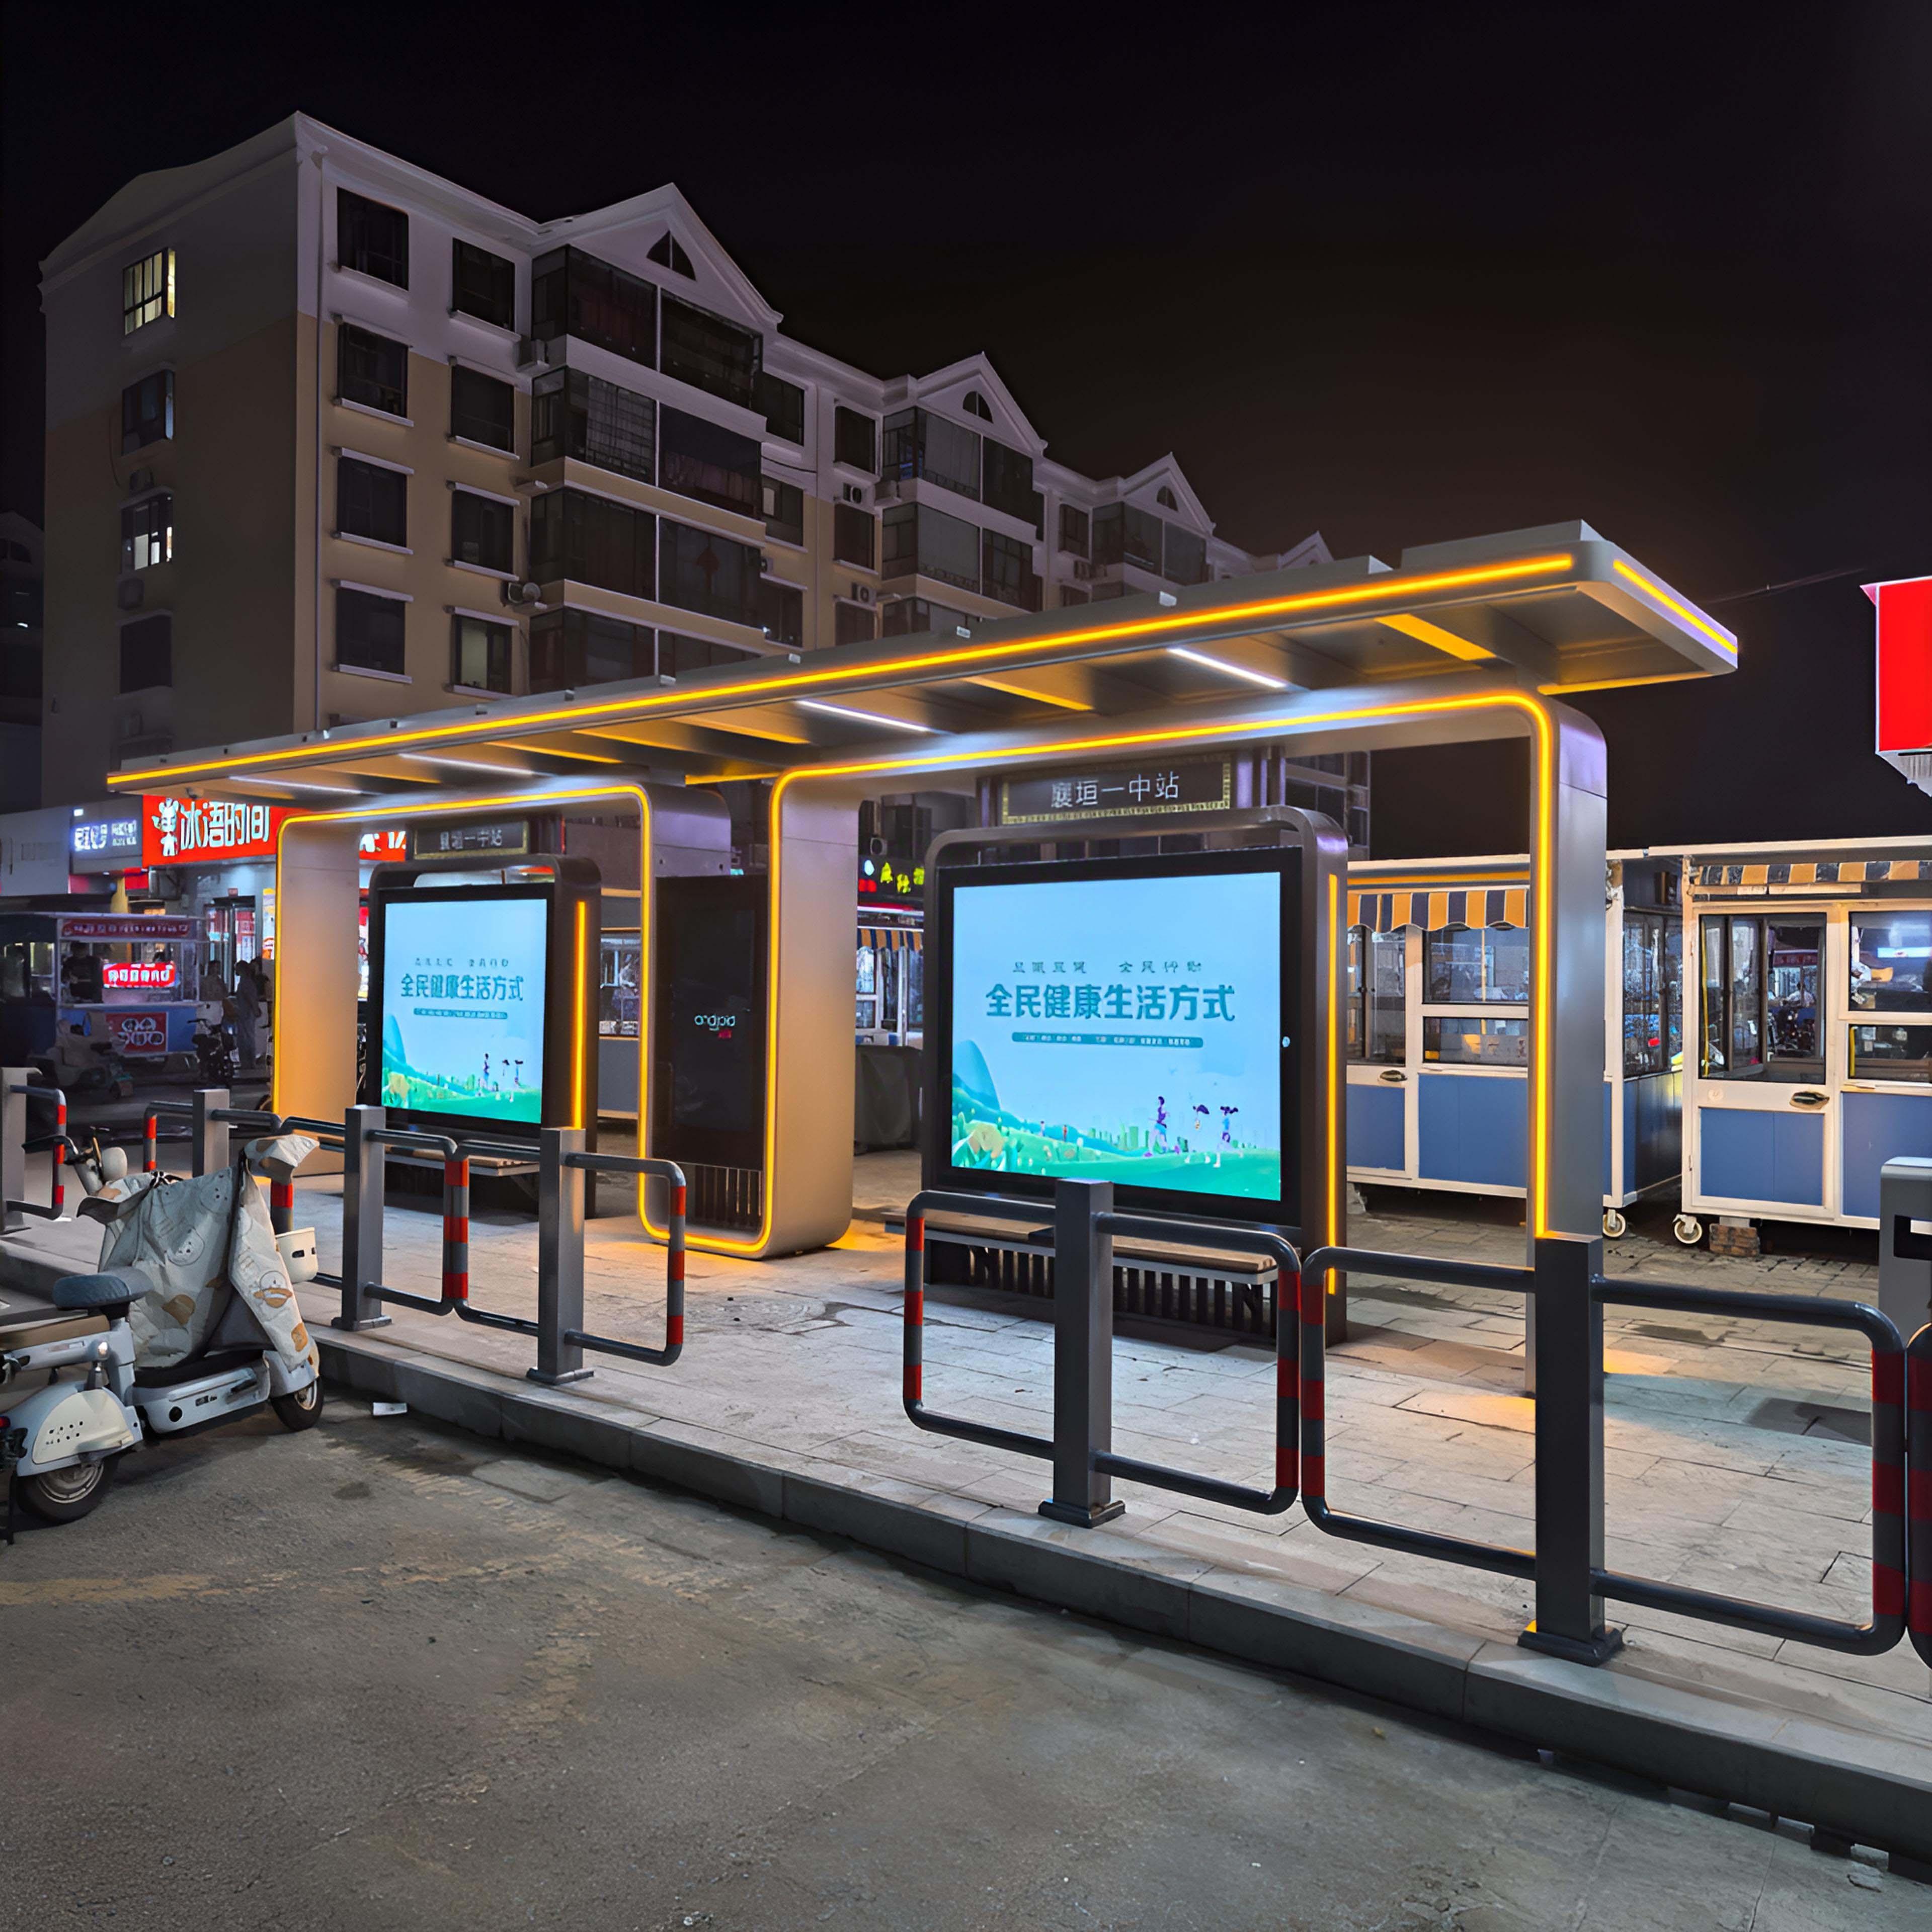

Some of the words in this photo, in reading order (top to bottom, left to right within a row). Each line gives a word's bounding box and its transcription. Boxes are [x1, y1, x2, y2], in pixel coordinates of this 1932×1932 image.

[180, 801, 270, 850] 冰语时间
[986, 984, 1235, 1021] 全民健康生活方式
